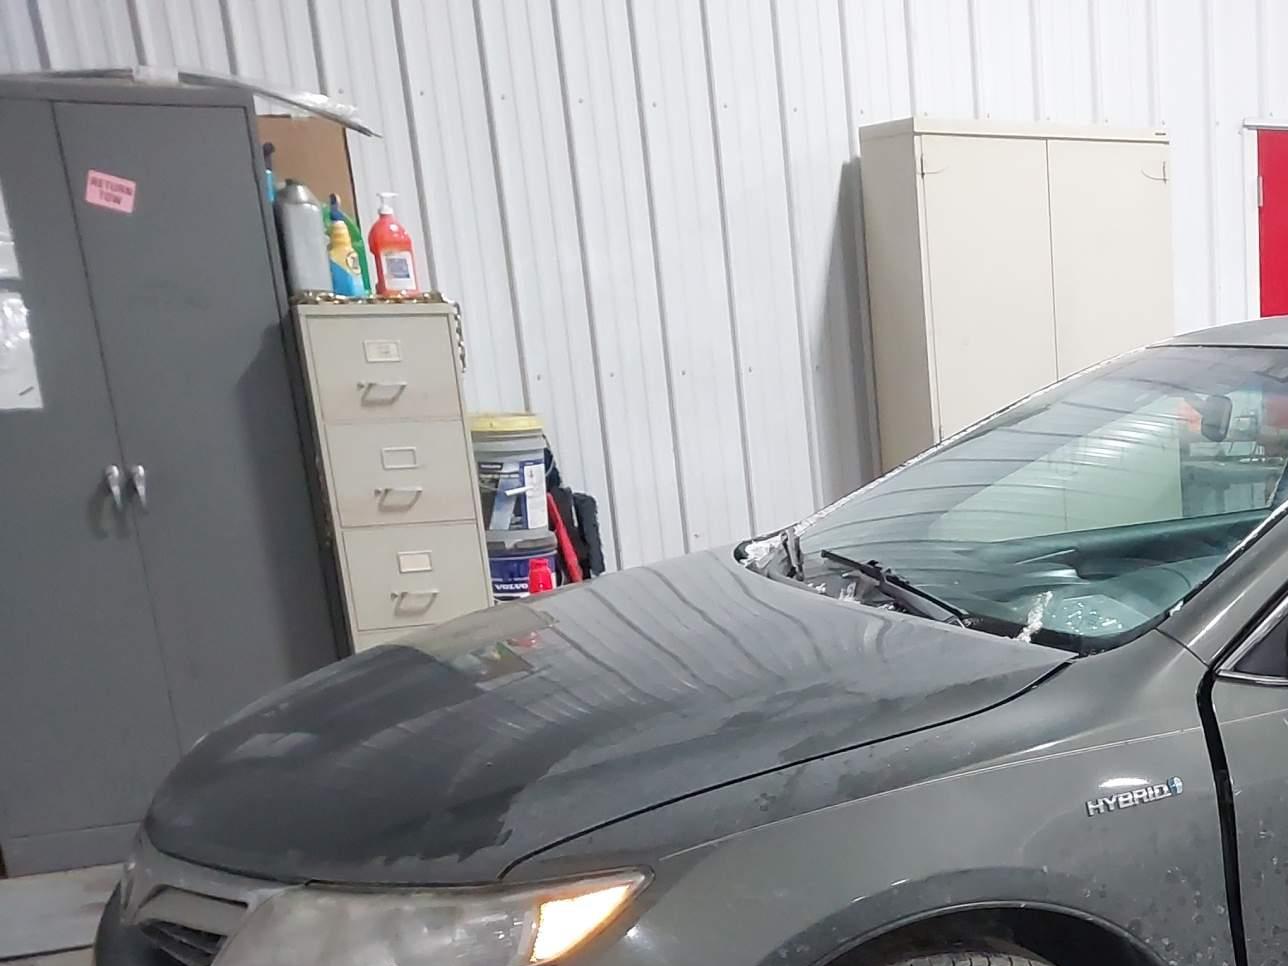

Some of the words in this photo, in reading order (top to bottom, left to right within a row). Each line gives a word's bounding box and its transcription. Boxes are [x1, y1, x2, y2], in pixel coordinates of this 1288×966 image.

[90, 176, 133, 196] RETURN
[99, 190, 122, 205] TOW
[494, 583, 529, 591] VOLVO
[1085, 783, 1172, 817] HYBRID
